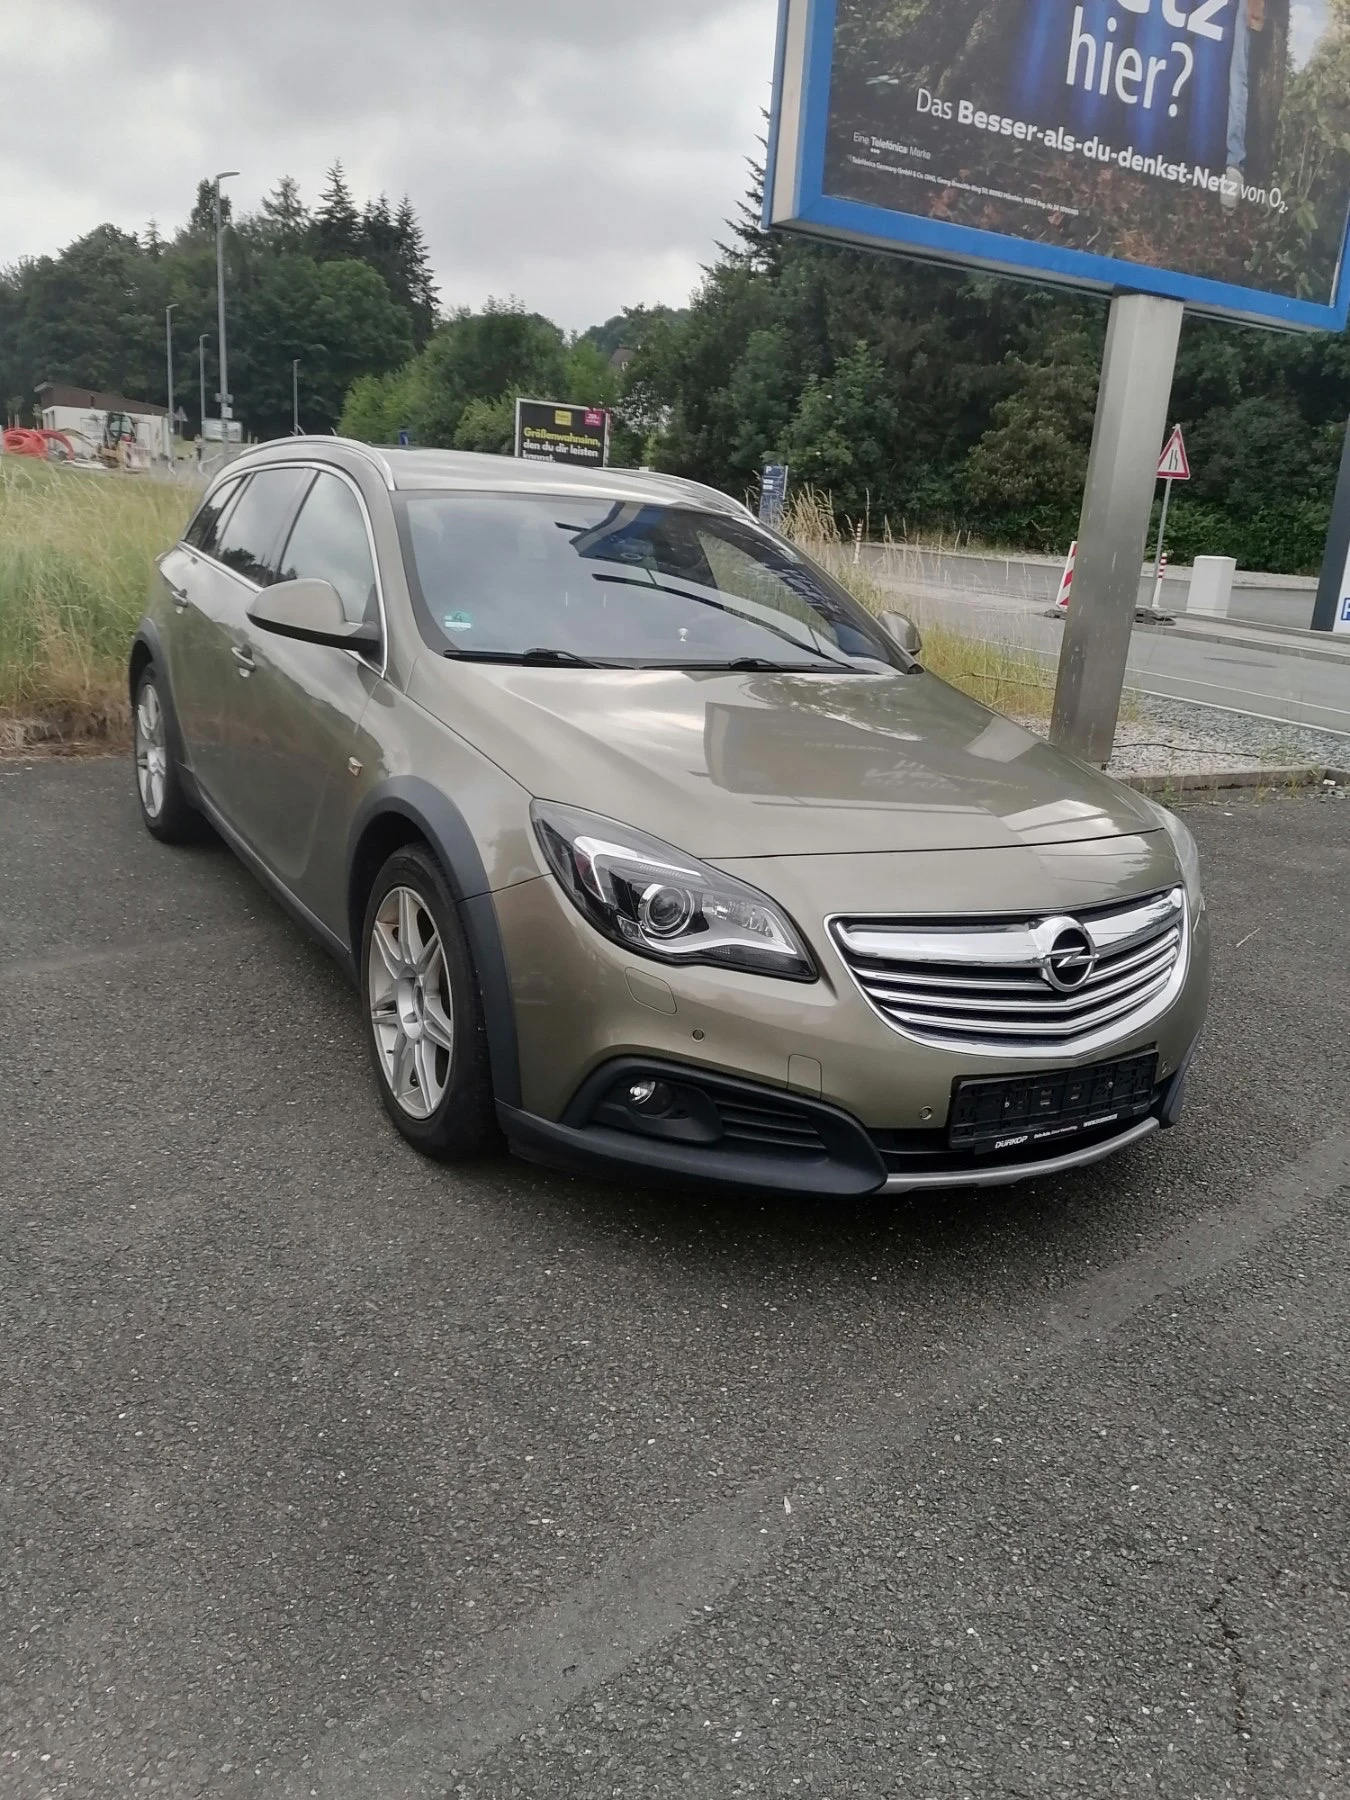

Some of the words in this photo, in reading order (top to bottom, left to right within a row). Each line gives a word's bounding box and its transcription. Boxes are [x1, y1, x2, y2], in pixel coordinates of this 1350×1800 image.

[1066, 5, 1194, 117] hier?
[853, 131, 869, 144] Eine
[871, 136, 908, 154] Telefónica
[909, 146, 931, 160] Marke
[916, 88, 952, 119] Das
[957, 99, 1238, 196] Besser-als-du-denkst-Netz
[1240, 183, 1265, 204] von
[523, 439, 541, 450] den
[542, 441, 554, 453] du
[555, 443, 569, 453] dir
[570, 444, 599, 457] leisten
